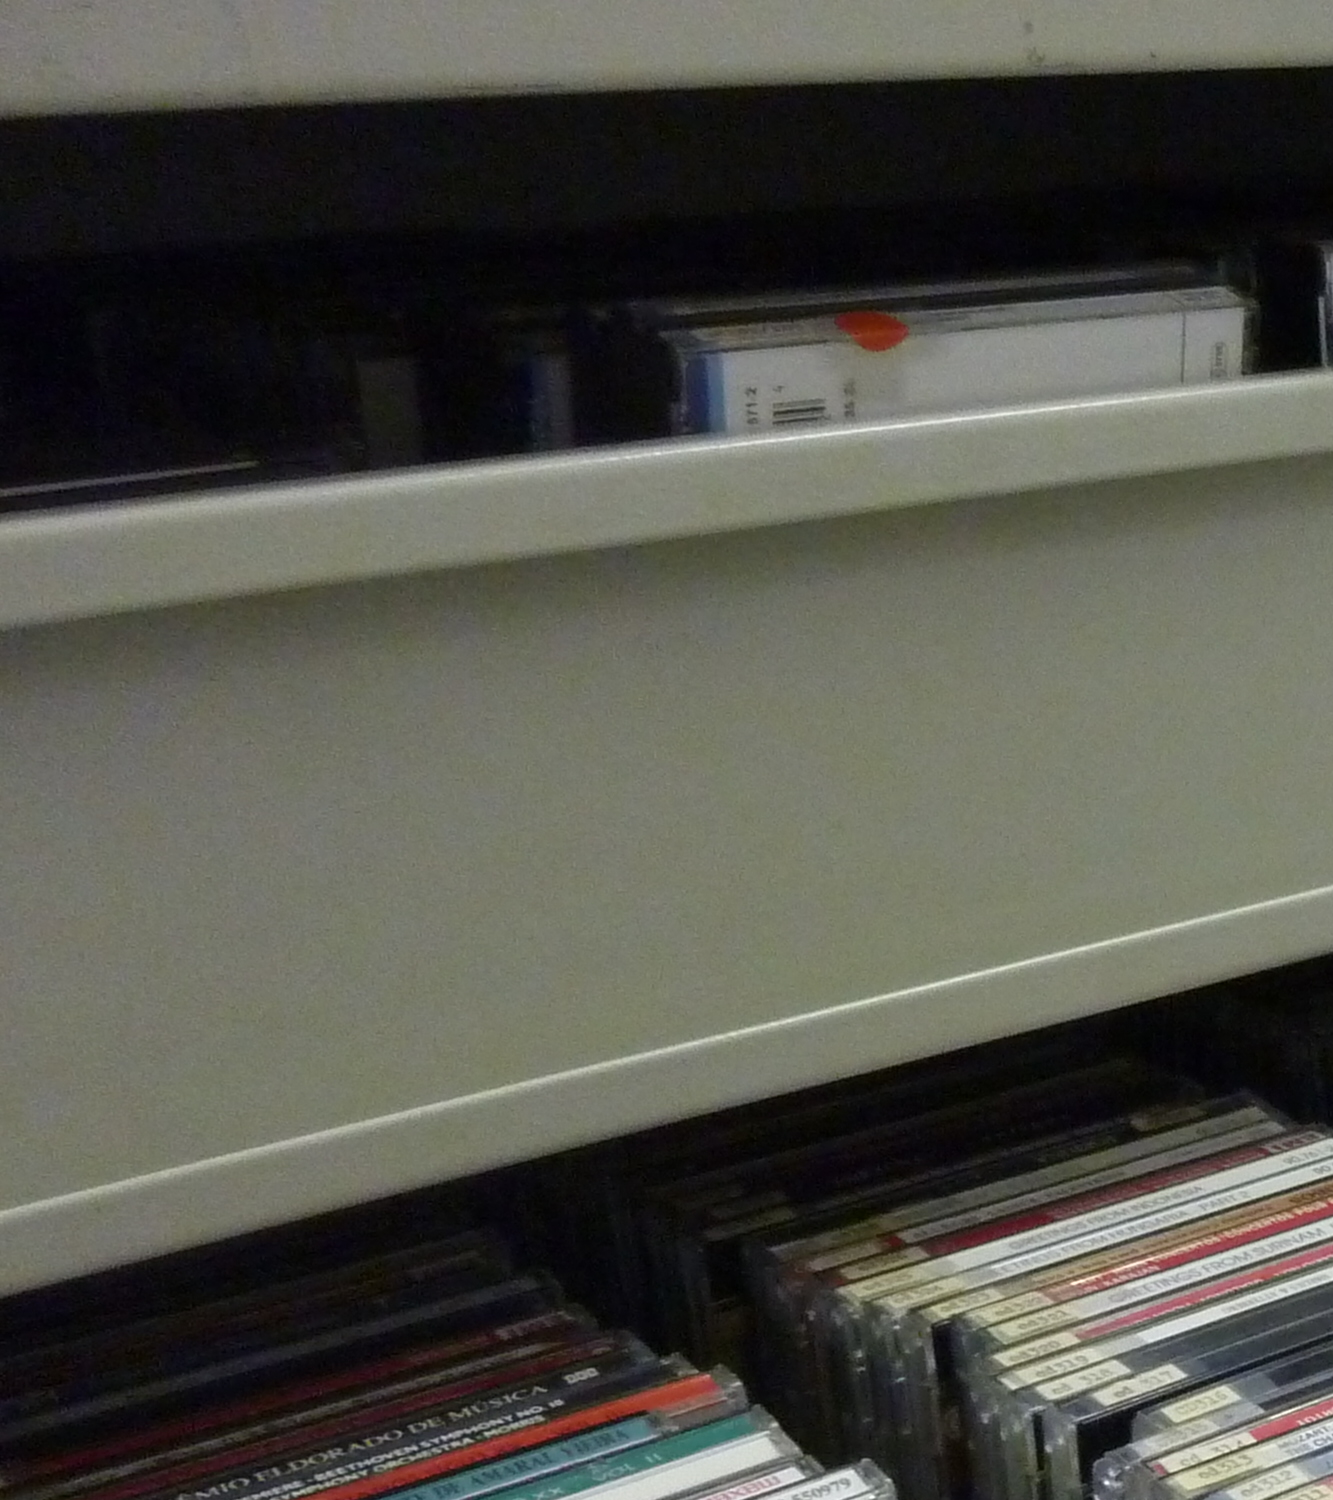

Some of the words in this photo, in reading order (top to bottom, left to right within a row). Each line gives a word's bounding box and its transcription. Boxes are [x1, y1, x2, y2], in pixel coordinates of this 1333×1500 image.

[1202, 1249, 1250, 1275] FROM
[1251, 1225, 1326, 1260] SURINAM
[256, 1425, 402, 1482] ELDORADO
[408, 1415, 447, 1436] DE
[450, 1383, 549, 1423] MÚSICA
[315, 1446, 415, 1482] BEETHOVEN
[418, 1412, 513, 1449] SYMPHONY
[373, 1437, 478, 1473] ORCHESTRA
[484, 1415, 546, 1438] MORRIS
